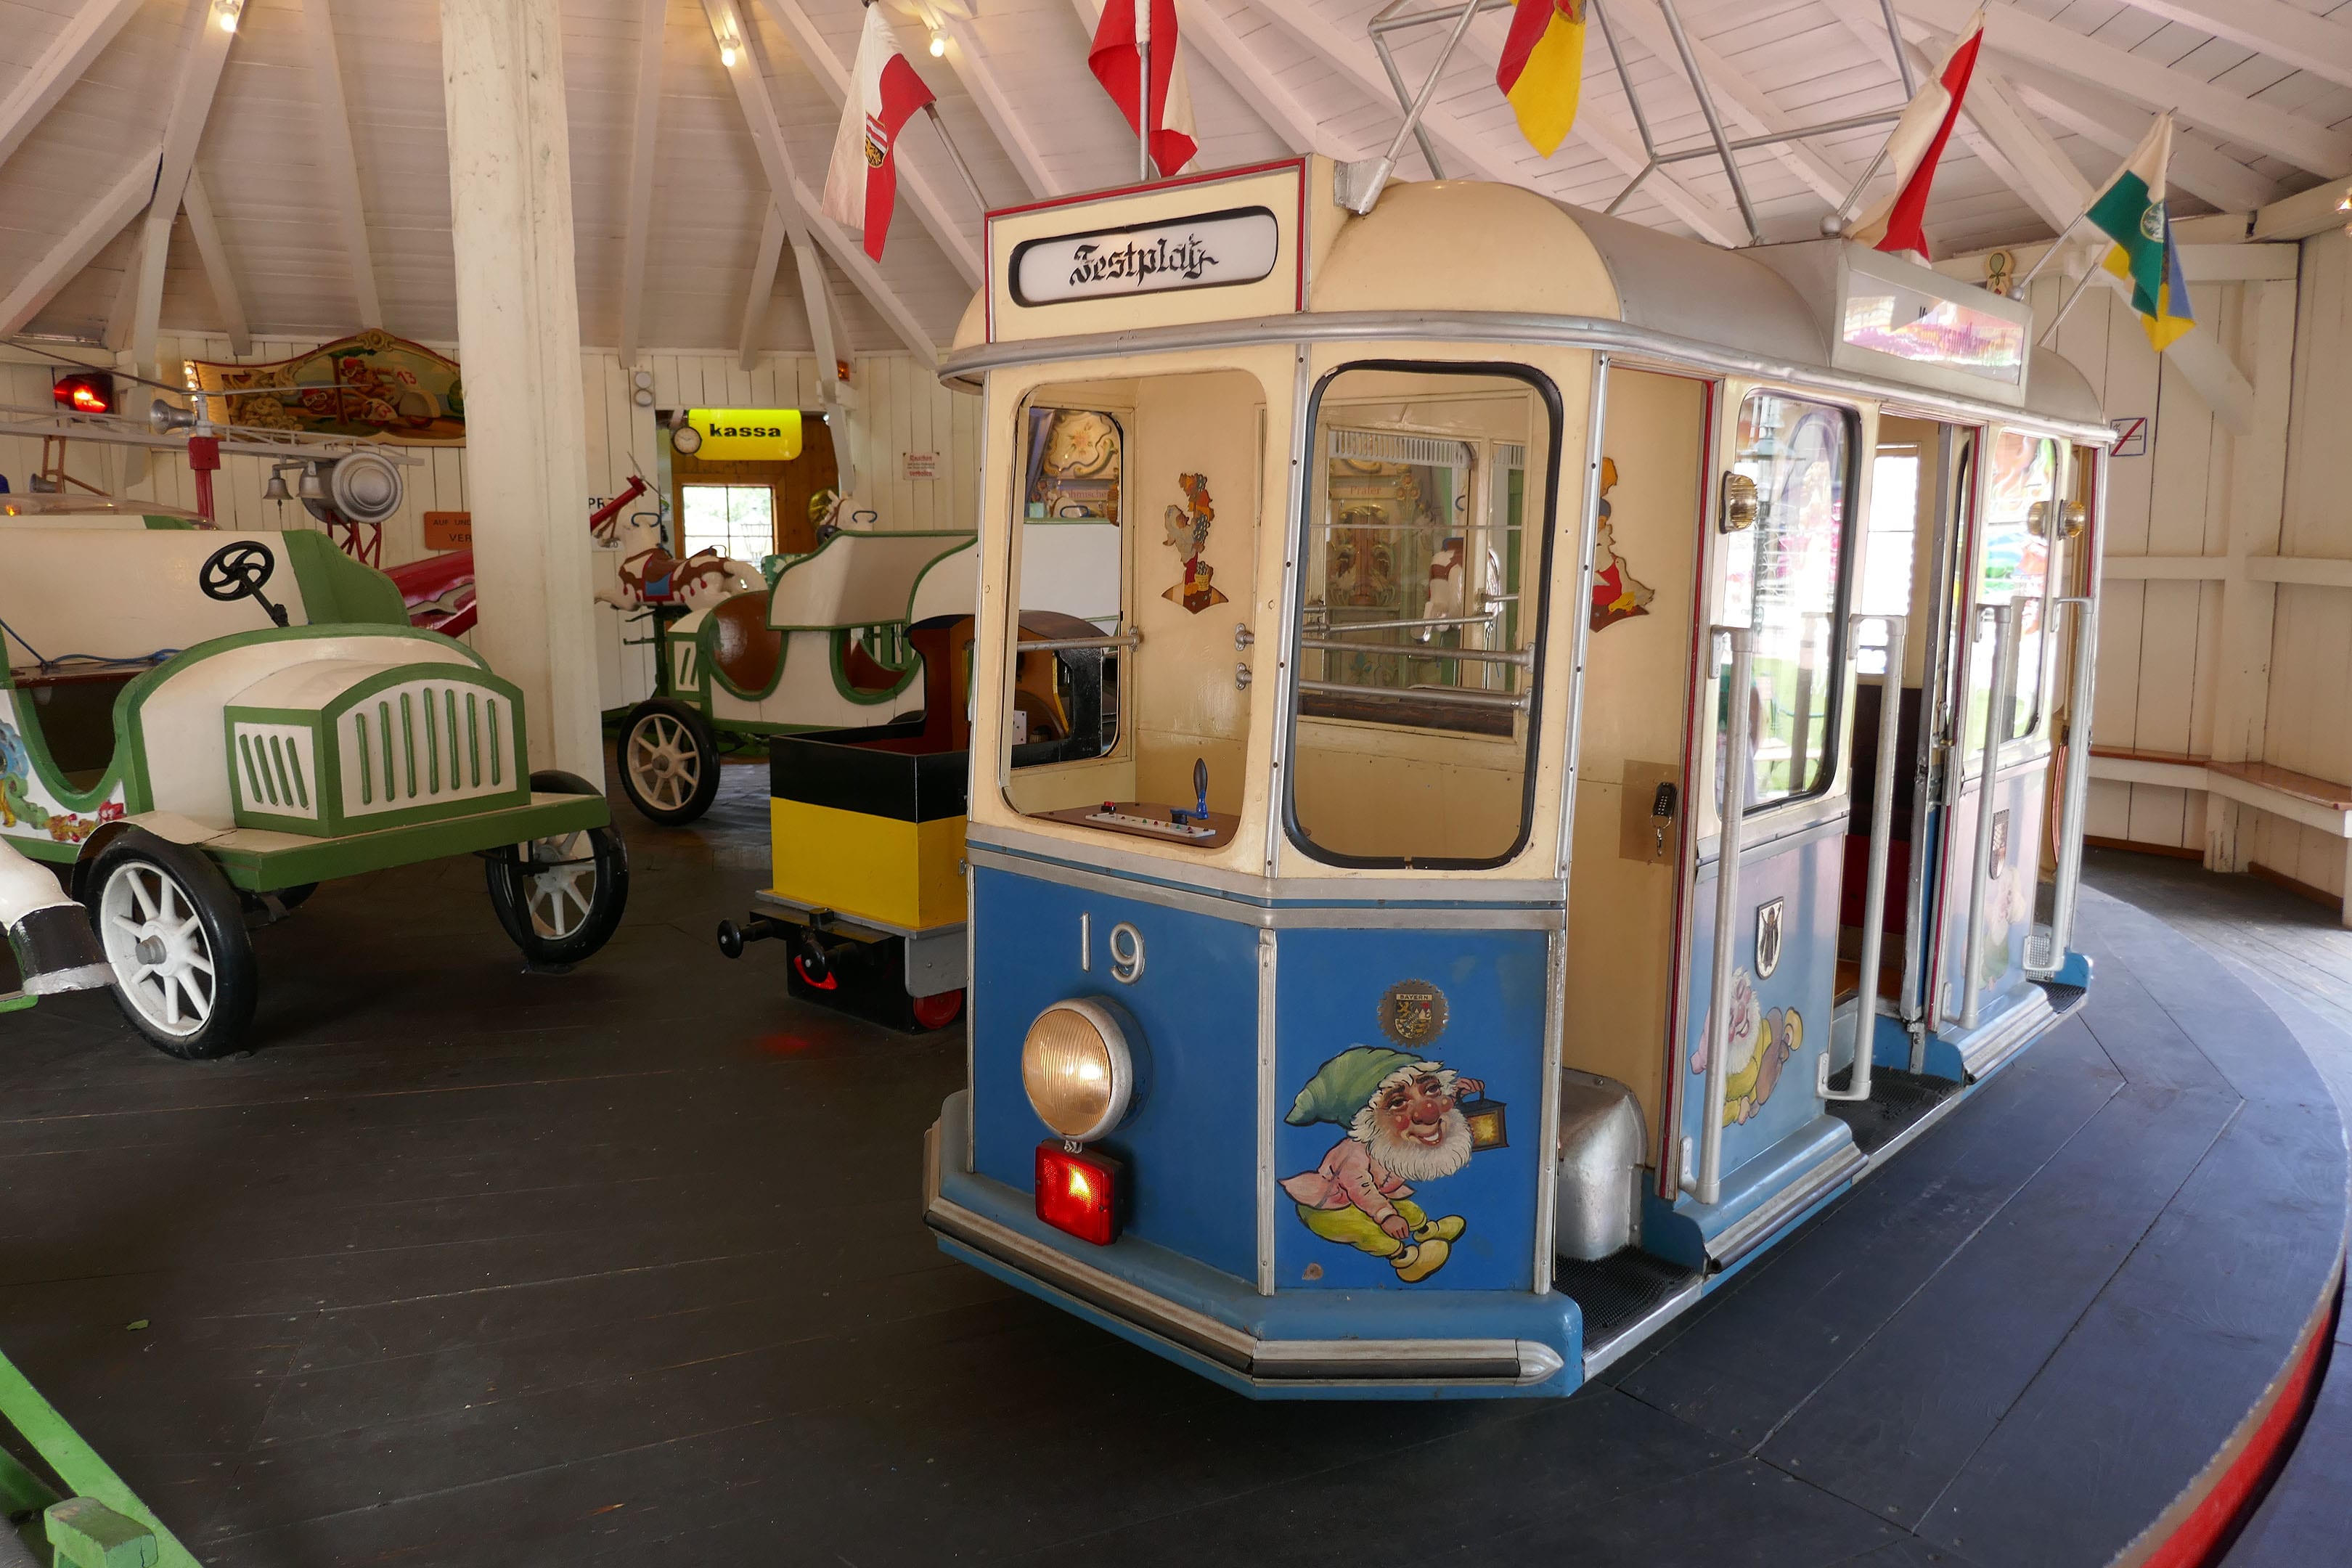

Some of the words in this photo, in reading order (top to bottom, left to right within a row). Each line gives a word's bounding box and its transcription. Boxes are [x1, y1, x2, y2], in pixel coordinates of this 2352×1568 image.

[396, 371, 417, 392] 13
[709, 423, 781, 437] kassa
[1349, 485, 1381, 495] Prater
[1080, 911, 1145, 985] 19
